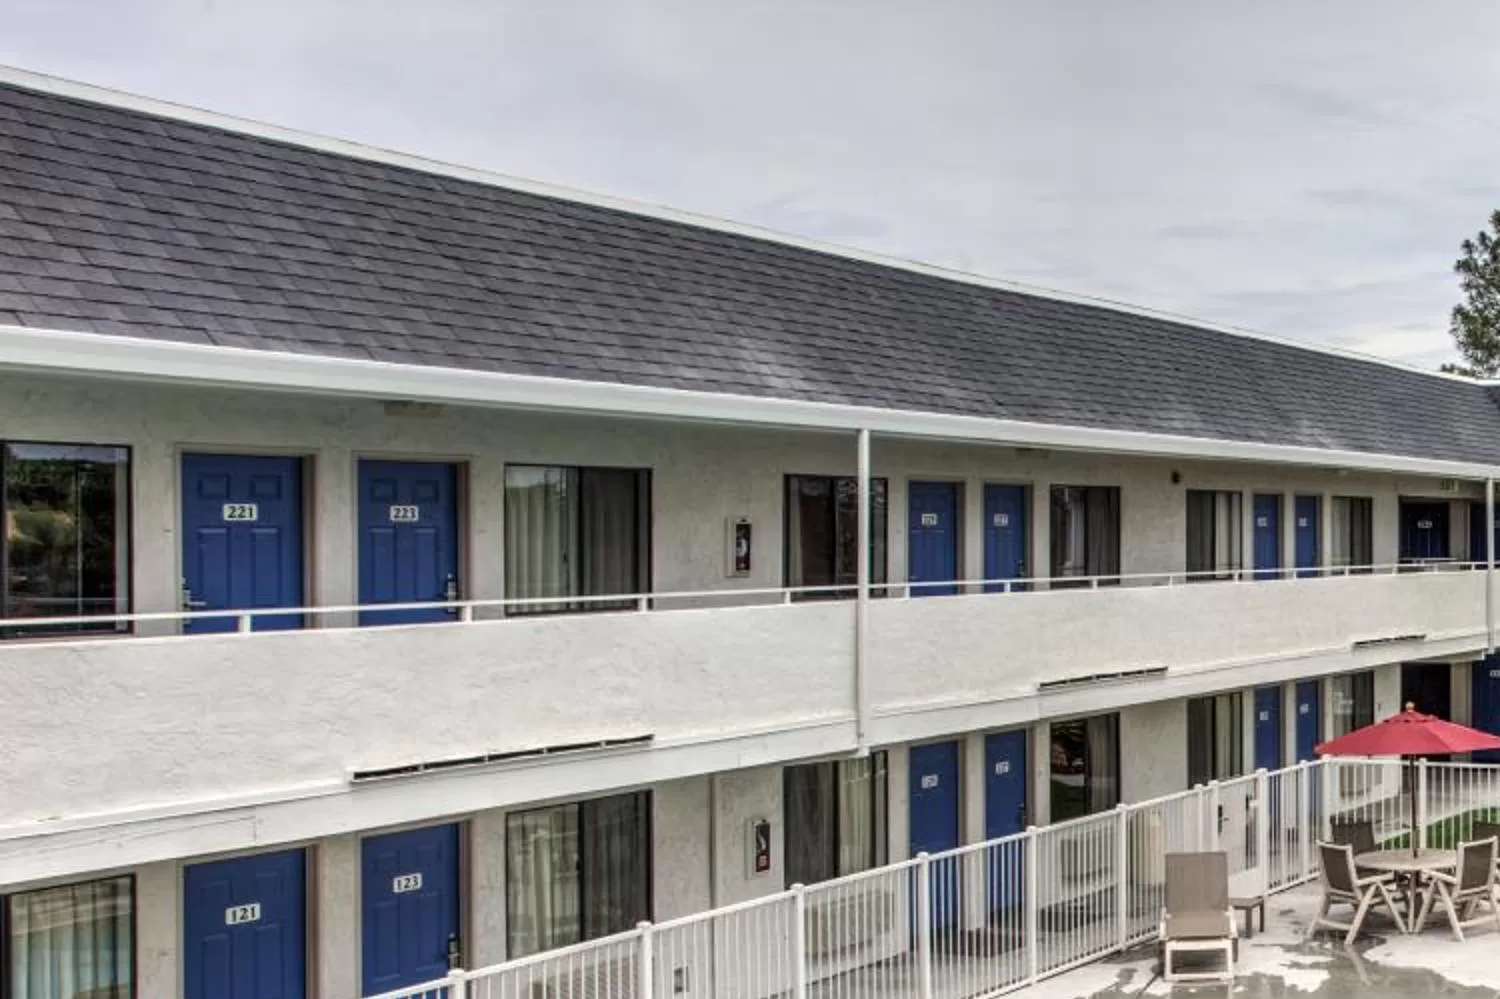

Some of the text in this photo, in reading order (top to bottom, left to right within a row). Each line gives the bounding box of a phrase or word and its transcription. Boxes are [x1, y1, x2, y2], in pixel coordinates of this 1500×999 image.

[228, 505, 253, 519] 221
[397, 875, 419, 890] 123
[231, 905, 256, 923] 121
